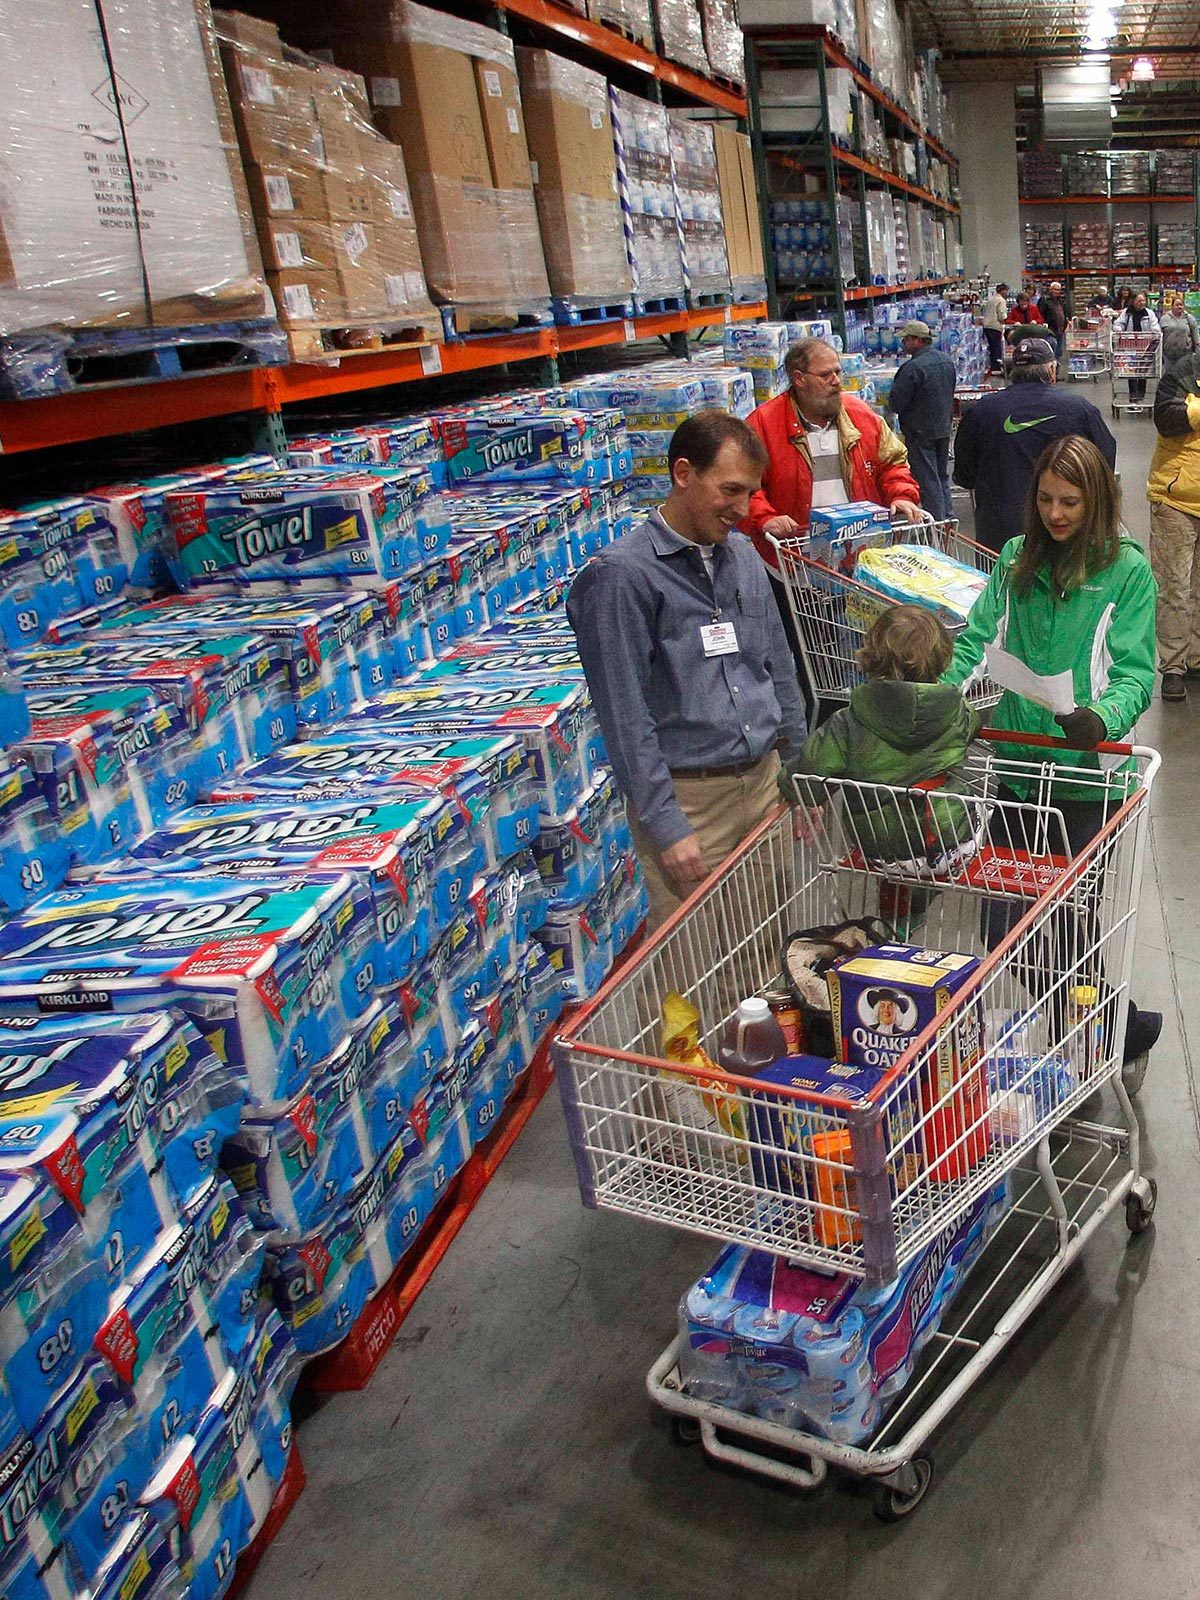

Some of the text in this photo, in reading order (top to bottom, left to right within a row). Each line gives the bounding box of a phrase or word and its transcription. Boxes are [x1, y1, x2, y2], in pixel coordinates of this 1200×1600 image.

[94, 193, 115, 202] MADE
[477, 430, 533, 471] Towel
[241, 490, 283, 499] KIRKLAND
[222, 506, 313, 566] Towel
[811, 521, 830, 537] Ziploc
[836, 518, 869, 539] Ziploc
[202, 559, 218, 572] 12
[351, 551, 368, 563] 80
[94, 575, 113, 594] 80
[437, 625, 449, 640] 80
[221, 664, 251, 701] Towel
[371, 665, 385, 684] 80
[270, 718, 284, 740] 80
[165, 781, 187, 804] 80
[166, 807, 376, 855] Towel
[515, 819, 530, 838] 80
[2, 895, 268, 960] Towel
[41, 970, 130, 983] KIRKLAND
[356, 966, 374, 993] 80
[40, 992, 109, 1006] KIRKLAND
[864, 1049, 899, 1067] OAT
[477, 1099, 496, 1125] 80
[3, 1124, 43, 1140] 80
[401, 1206, 418, 1237] 80
[807, 1298, 828, 1314] 36
[38, 1319, 73, 1374] 80
[1, 1430, 59, 1543] Towel
[214, 1538, 234, 1580] 12
